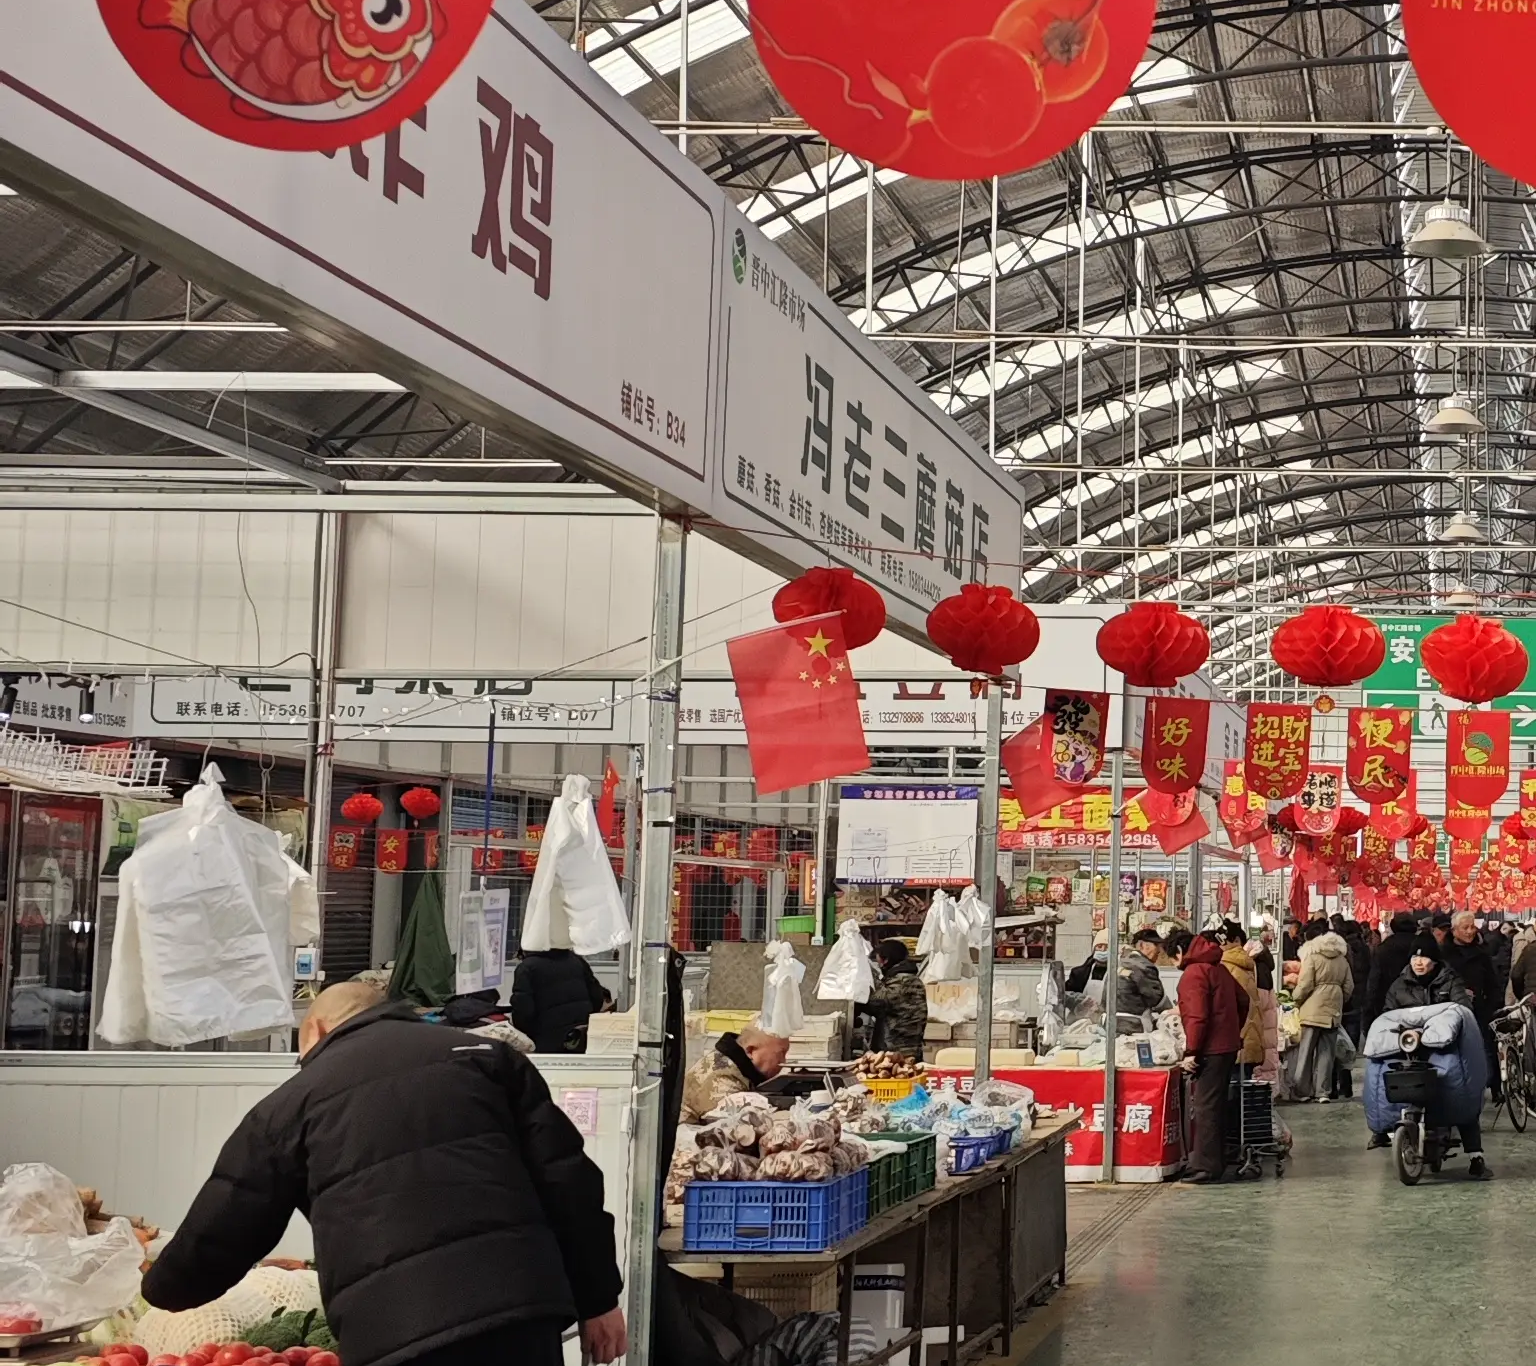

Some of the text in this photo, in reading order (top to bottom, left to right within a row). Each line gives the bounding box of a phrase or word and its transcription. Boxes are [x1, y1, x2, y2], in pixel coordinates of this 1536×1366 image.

[750, 252, 806, 333] 晋中汇隆市场
[1390, 636, 1416, 664] 安
[1156, 717, 1193, 784] 好味
